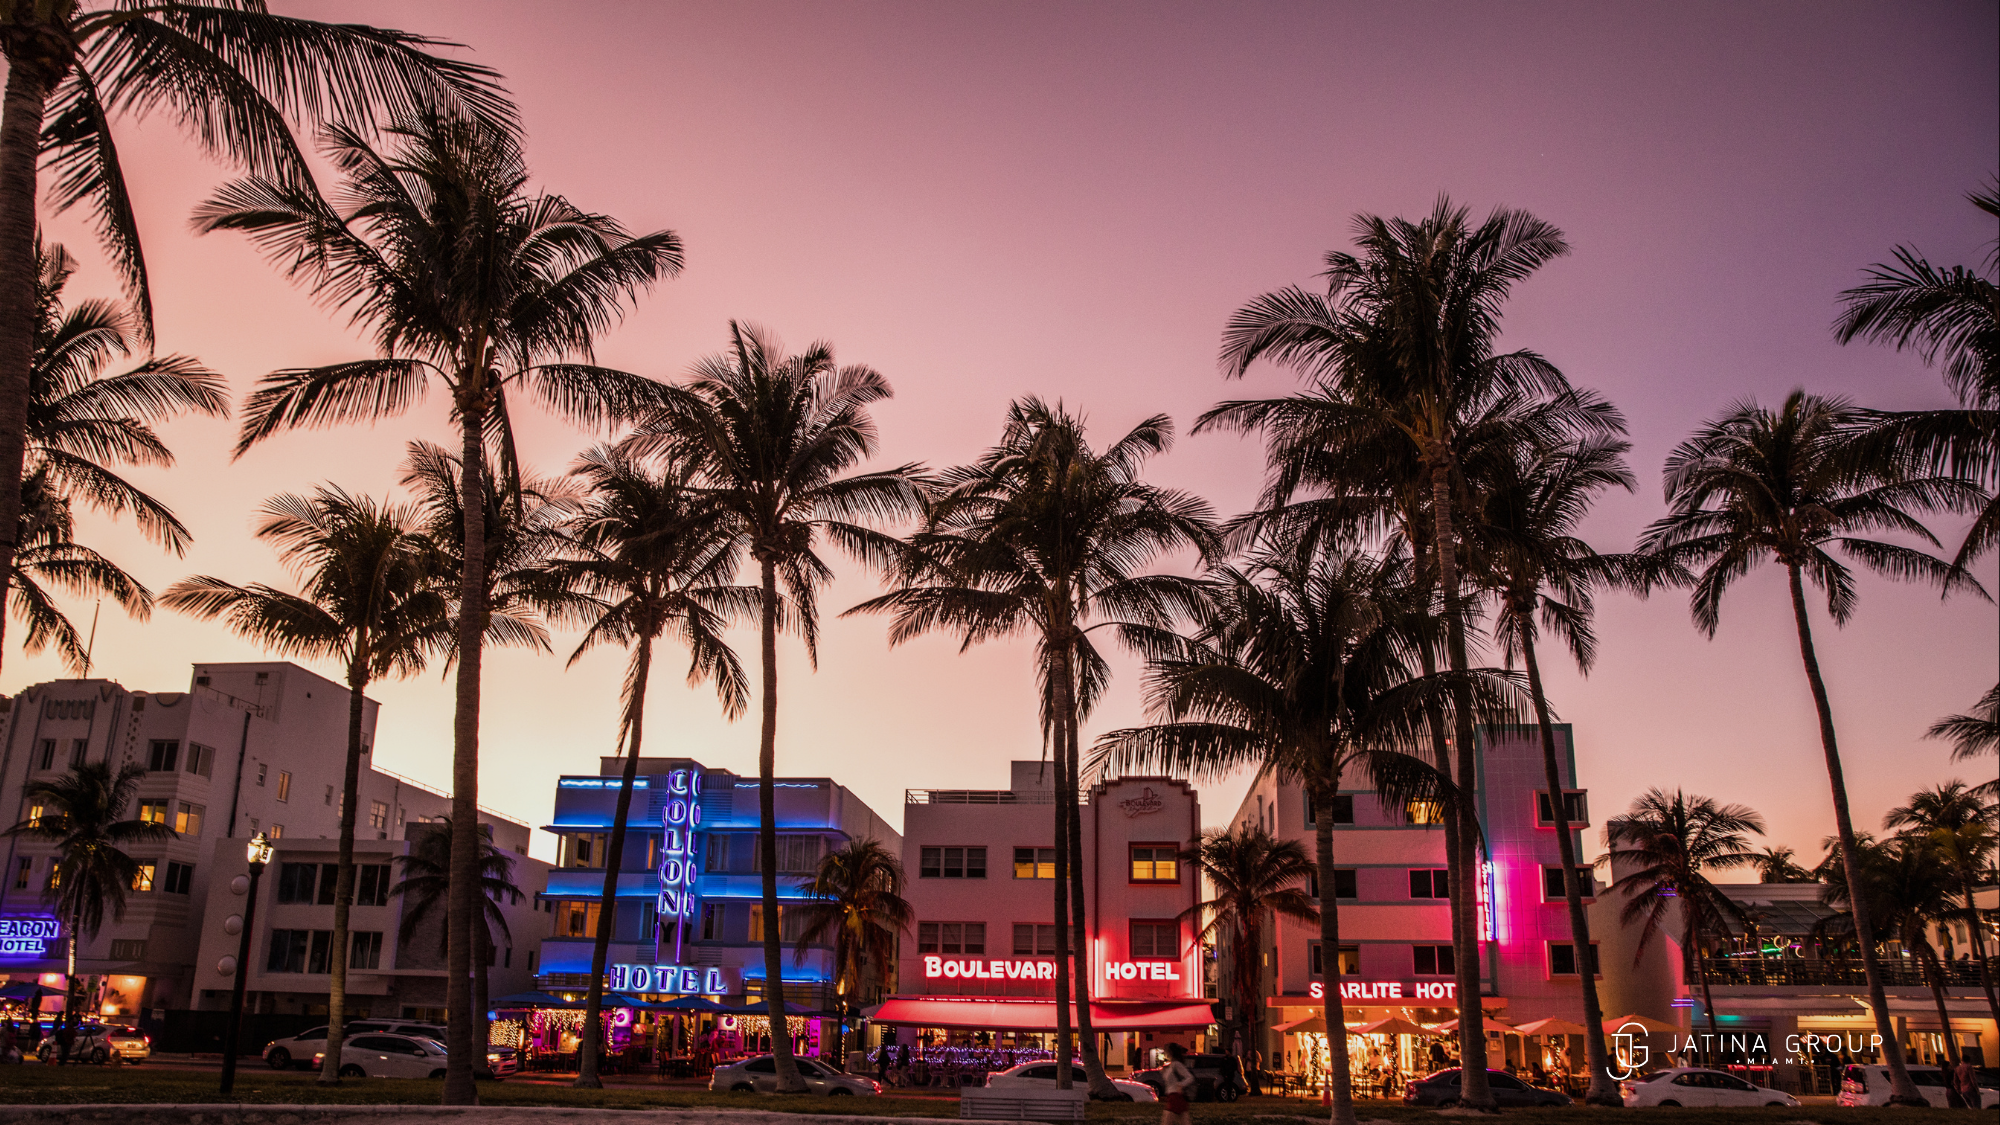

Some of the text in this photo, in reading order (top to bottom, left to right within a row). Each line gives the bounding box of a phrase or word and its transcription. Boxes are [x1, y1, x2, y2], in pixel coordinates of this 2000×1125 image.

[659, 769, 688, 943] COLONY
[0, 920, 59, 938] EACON
[609, 966, 728, 993] HOTEL
[1105, 961, 1180, 980] HOTEL
[1310, 982, 1457, 999] SARLITE HOT
